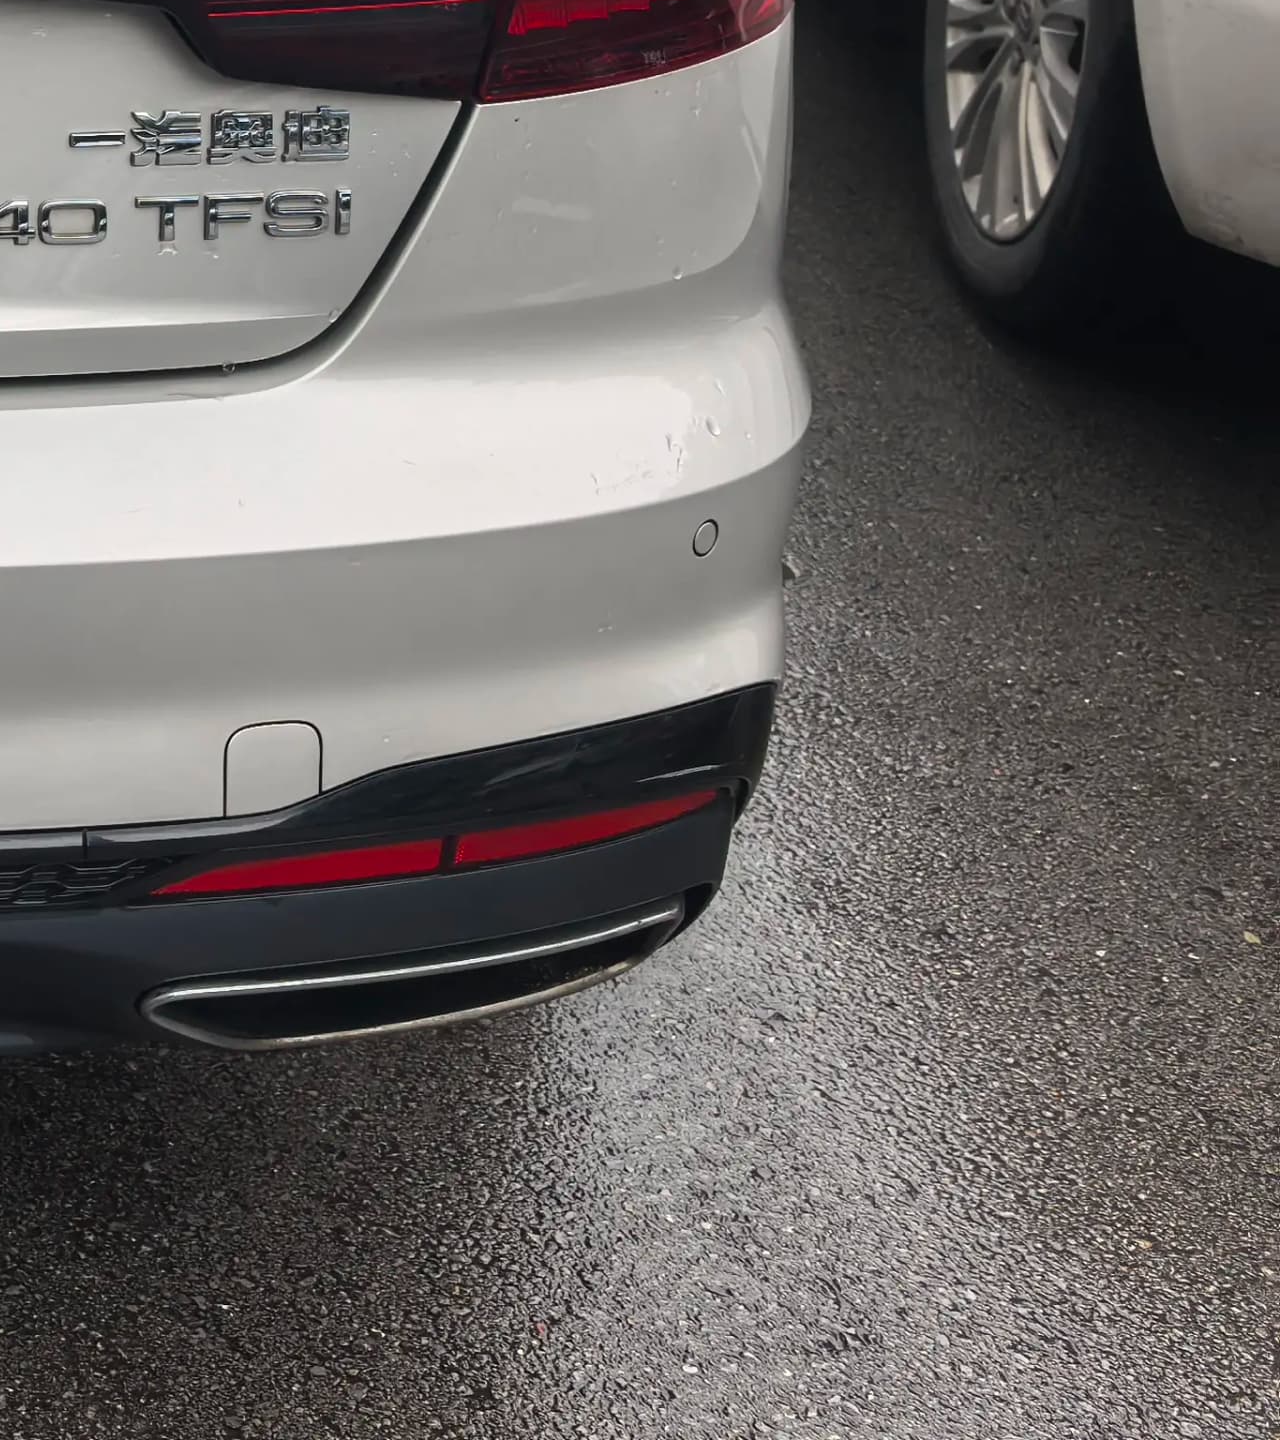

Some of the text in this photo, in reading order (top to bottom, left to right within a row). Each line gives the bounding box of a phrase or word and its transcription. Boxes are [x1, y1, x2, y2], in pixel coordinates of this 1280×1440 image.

[68, 105, 352, 167] 一汽奥迪
[134, 187, 353, 241] TFSI
